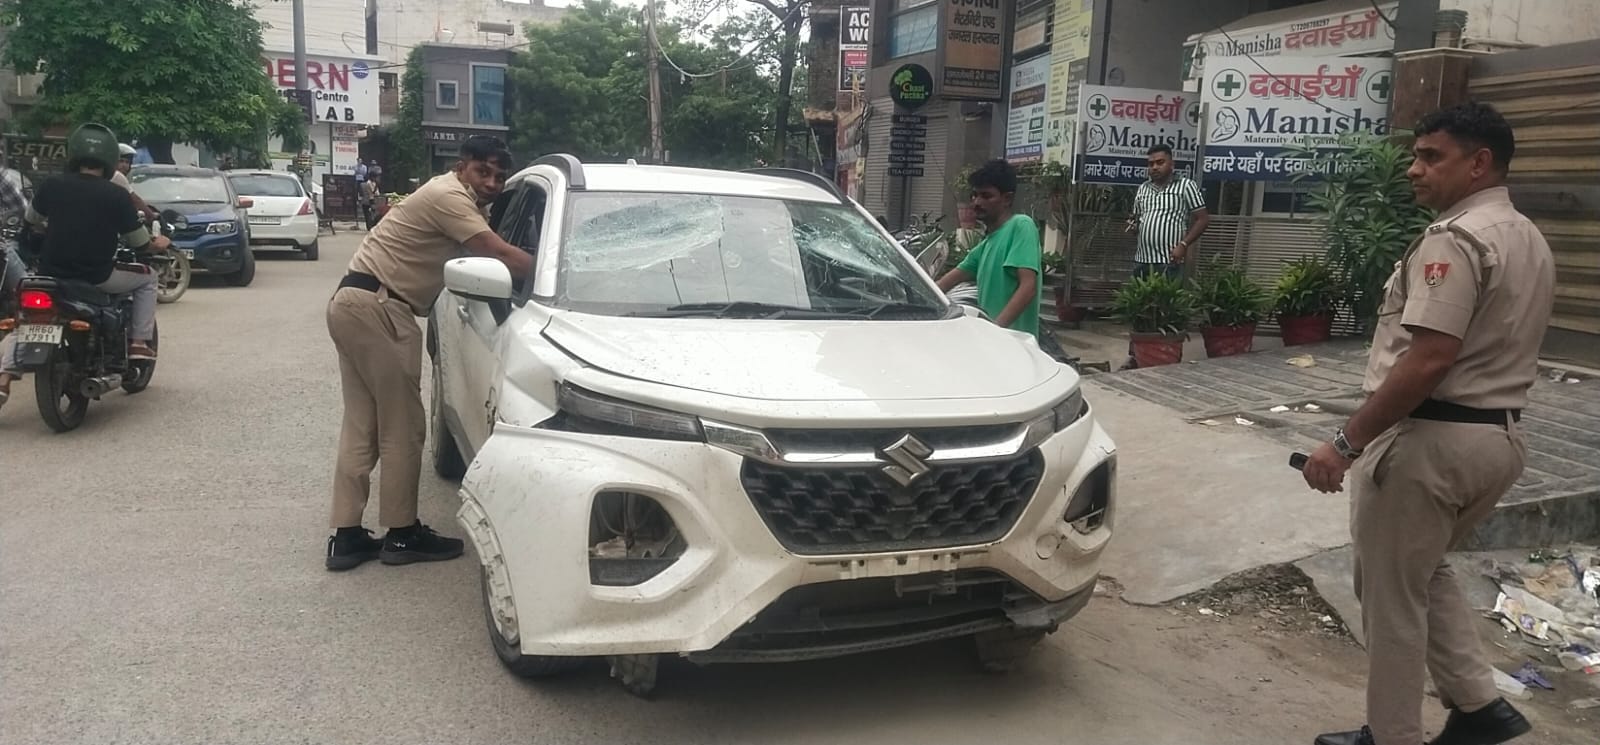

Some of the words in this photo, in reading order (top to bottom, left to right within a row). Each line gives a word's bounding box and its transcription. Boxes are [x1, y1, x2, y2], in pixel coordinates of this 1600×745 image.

[1224, 33, 1282, 57] Manisha
[1248, 64, 1366, 102] दवाईयाँ
[315, 90, 349, 103] Centre
[1244, 106, 1389, 136] Manisha
[1108, 124, 1198, 151] Manisha
[1243, 135, 1288, 145] Maternity
[1292, 136, 1304, 145] An
[1108, 146, 1137, 157] Maternity
[1203, 151, 1235, 174] हमारे
[1236, 150, 1265, 174] यहाँ
[1265, 157, 1282, 173] पर
[1121, 165, 1134, 178] पर
[28, 326, 55, 335] HR60
